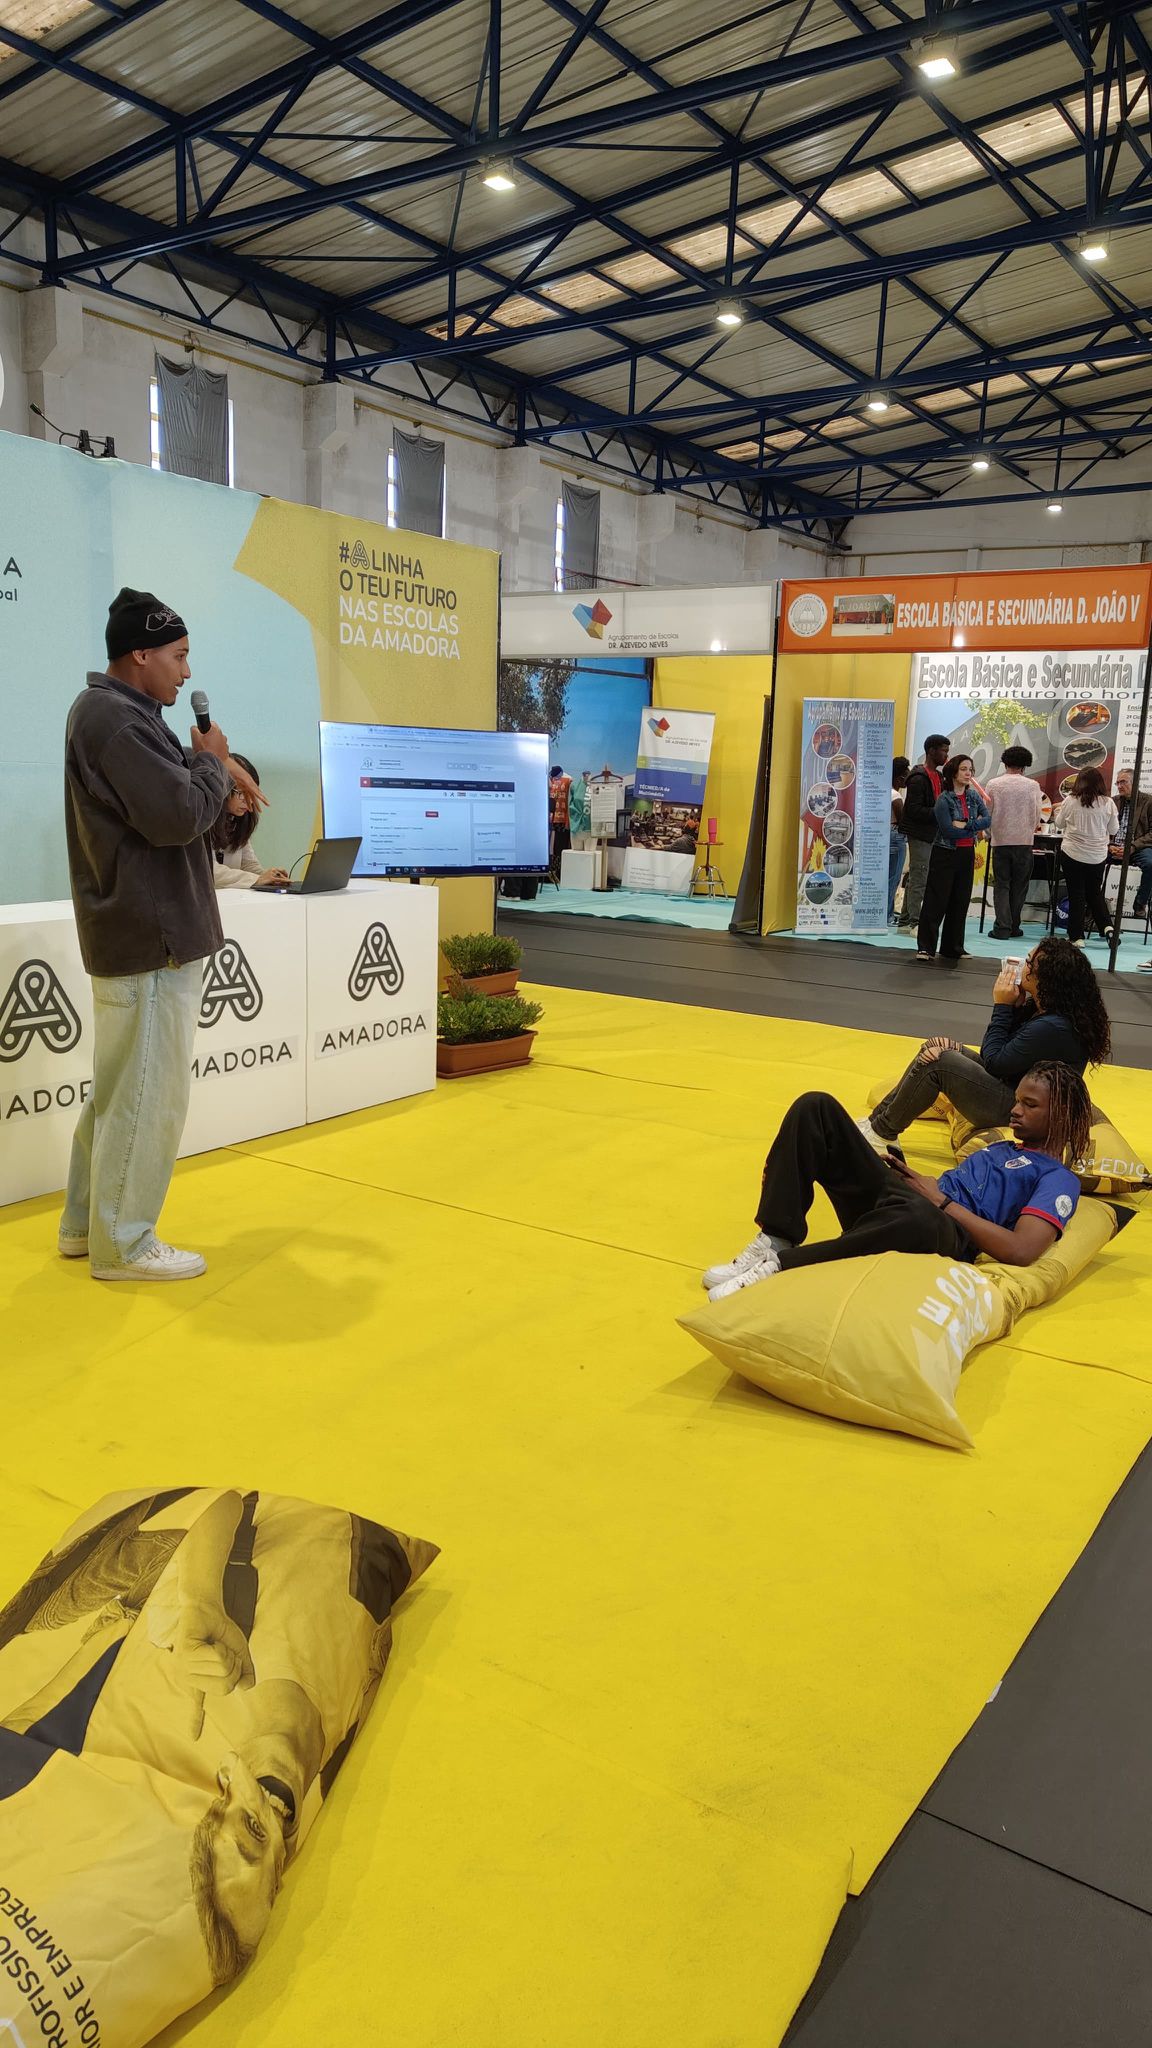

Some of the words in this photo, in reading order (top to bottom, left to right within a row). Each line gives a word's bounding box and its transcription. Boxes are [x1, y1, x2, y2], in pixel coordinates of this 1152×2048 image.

[340, 569, 353, 591] O
[357, 572, 389, 598] TEU
[394, 580, 456, 610] FUTURO
[339, 595, 378, 622] NAS
[383, 602, 459, 635] ESCOLAS
[897, 602, 939, 628] ESCOLA
[942, 595, 983, 627] BÁSICA
[986, 600, 995, 625] E
[997, 592, 1073, 626] SECUNDÁRIA
[1076, 597, 1088, 624] D.
[1091, 590, 1127, 624] JOÃO
[1130, 594, 1140, 622] V
[340, 622, 367, 646] DA
[372, 628, 460, 659] AMADORA
[608, 633, 647, 641] Agrupamento
[658, 632, 679, 640] Escolas
[918, 656, 967, 689] Escola
[972, 655, 1023, 689] Básica
[1027, 662, 1037, 688] e
[1041, 654, 1132, 689] Secundária
[917, 689, 960, 698] Com
[989, 689, 1056, 699] futuro
[1065, 690, 1094, 699] no
[321, 1014, 426, 1052] AMADORA
[63, 1976, 84, 2000] E
